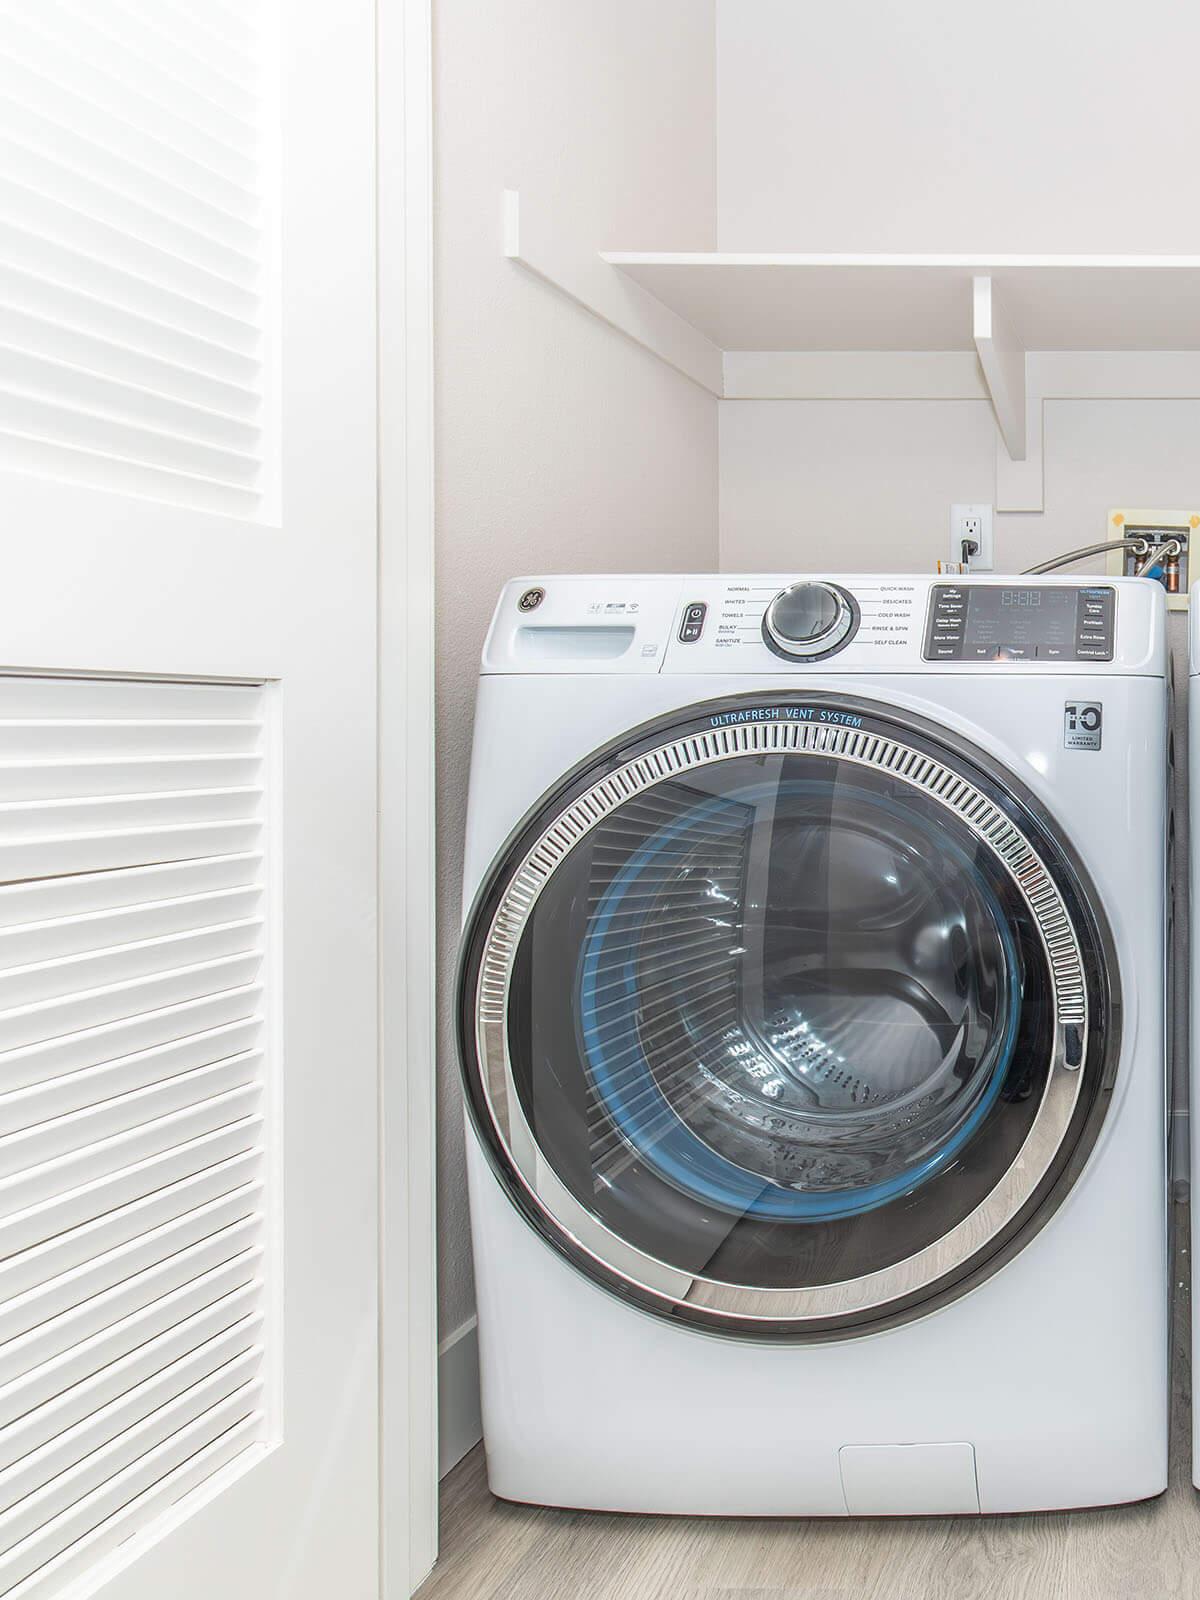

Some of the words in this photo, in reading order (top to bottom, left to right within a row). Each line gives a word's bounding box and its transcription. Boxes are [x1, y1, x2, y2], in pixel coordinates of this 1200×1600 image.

[710, 708, 780, 727] ULTRAFRESH
[785, 708, 815, 720] VENT
[819, 710, 863, 729] SYSTEM
